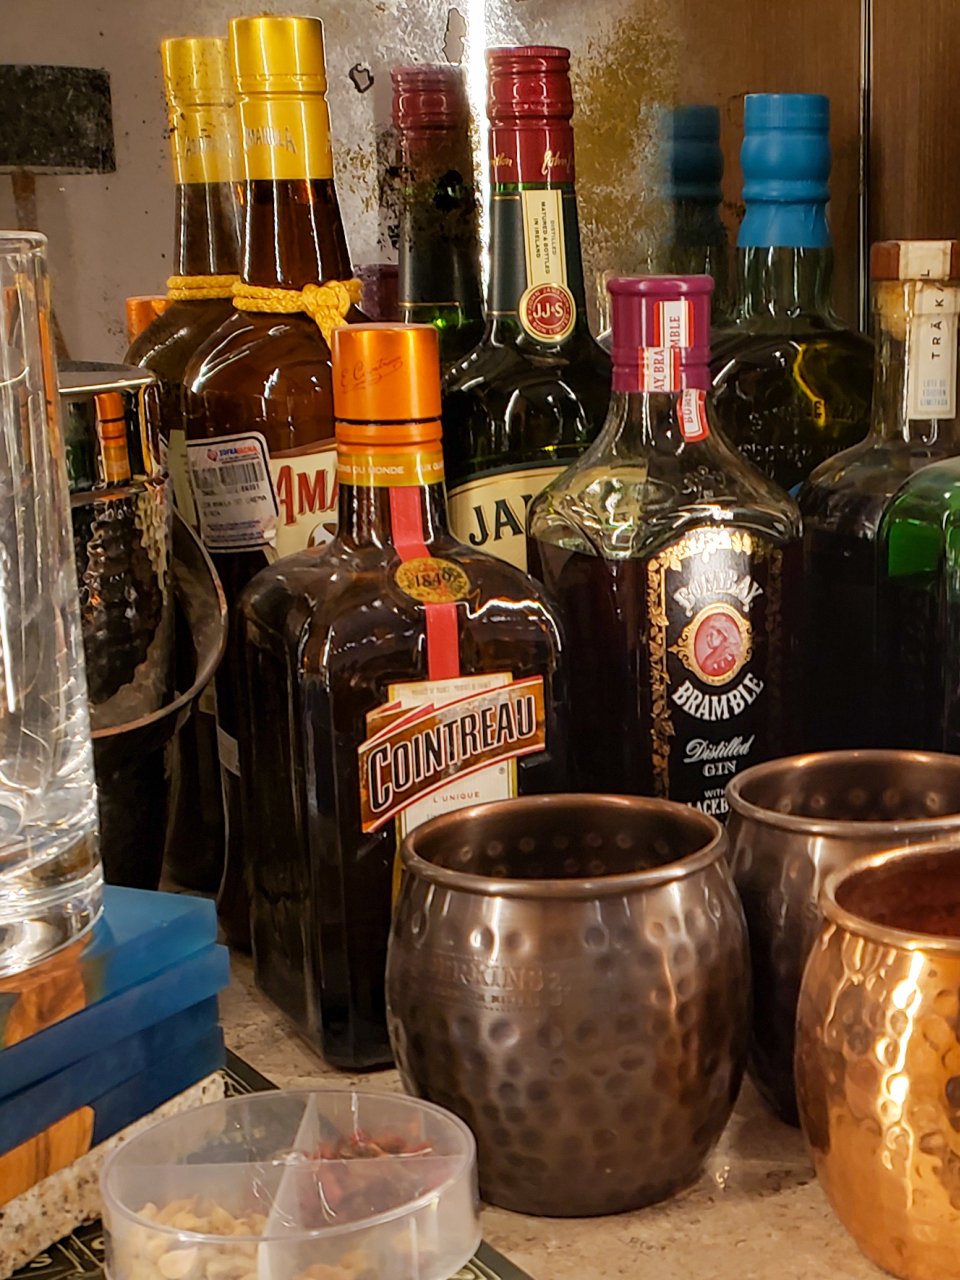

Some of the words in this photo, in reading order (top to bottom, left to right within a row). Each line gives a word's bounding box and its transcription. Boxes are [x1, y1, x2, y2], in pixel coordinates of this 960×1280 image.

[671, 673, 764, 721] BRAMBLE
[368, 694, 536, 813] COINTREAU
[683, 734, 756, 763] Distilled
[702, 760, 737, 777] GIN
